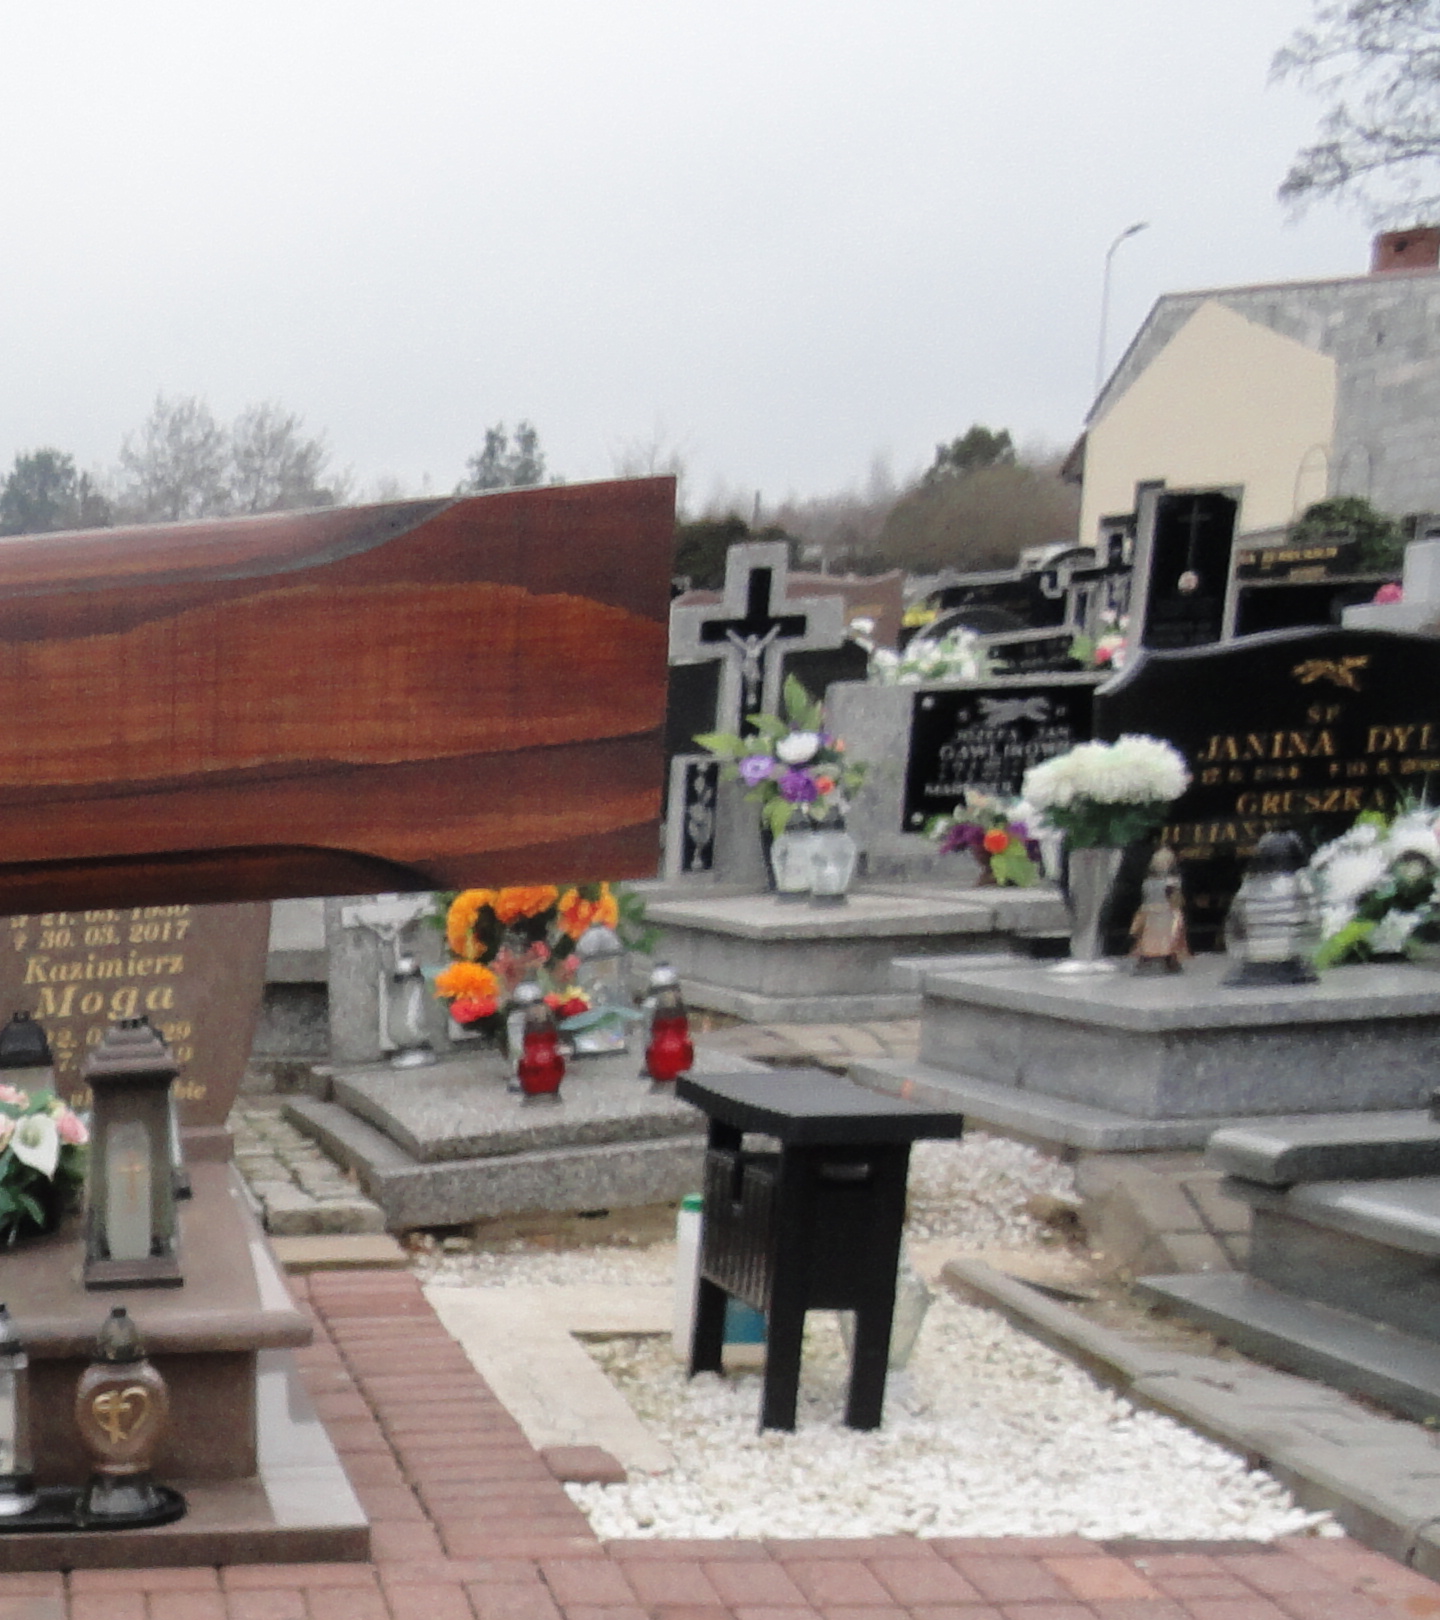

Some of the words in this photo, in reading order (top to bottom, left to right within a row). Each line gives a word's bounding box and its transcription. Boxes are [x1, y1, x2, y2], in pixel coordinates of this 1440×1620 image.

[1197, 728, 1335, 761] JANINA
[23, 950, 185, 985] Kazimierz
[32, 983, 175, 1021] Moga
